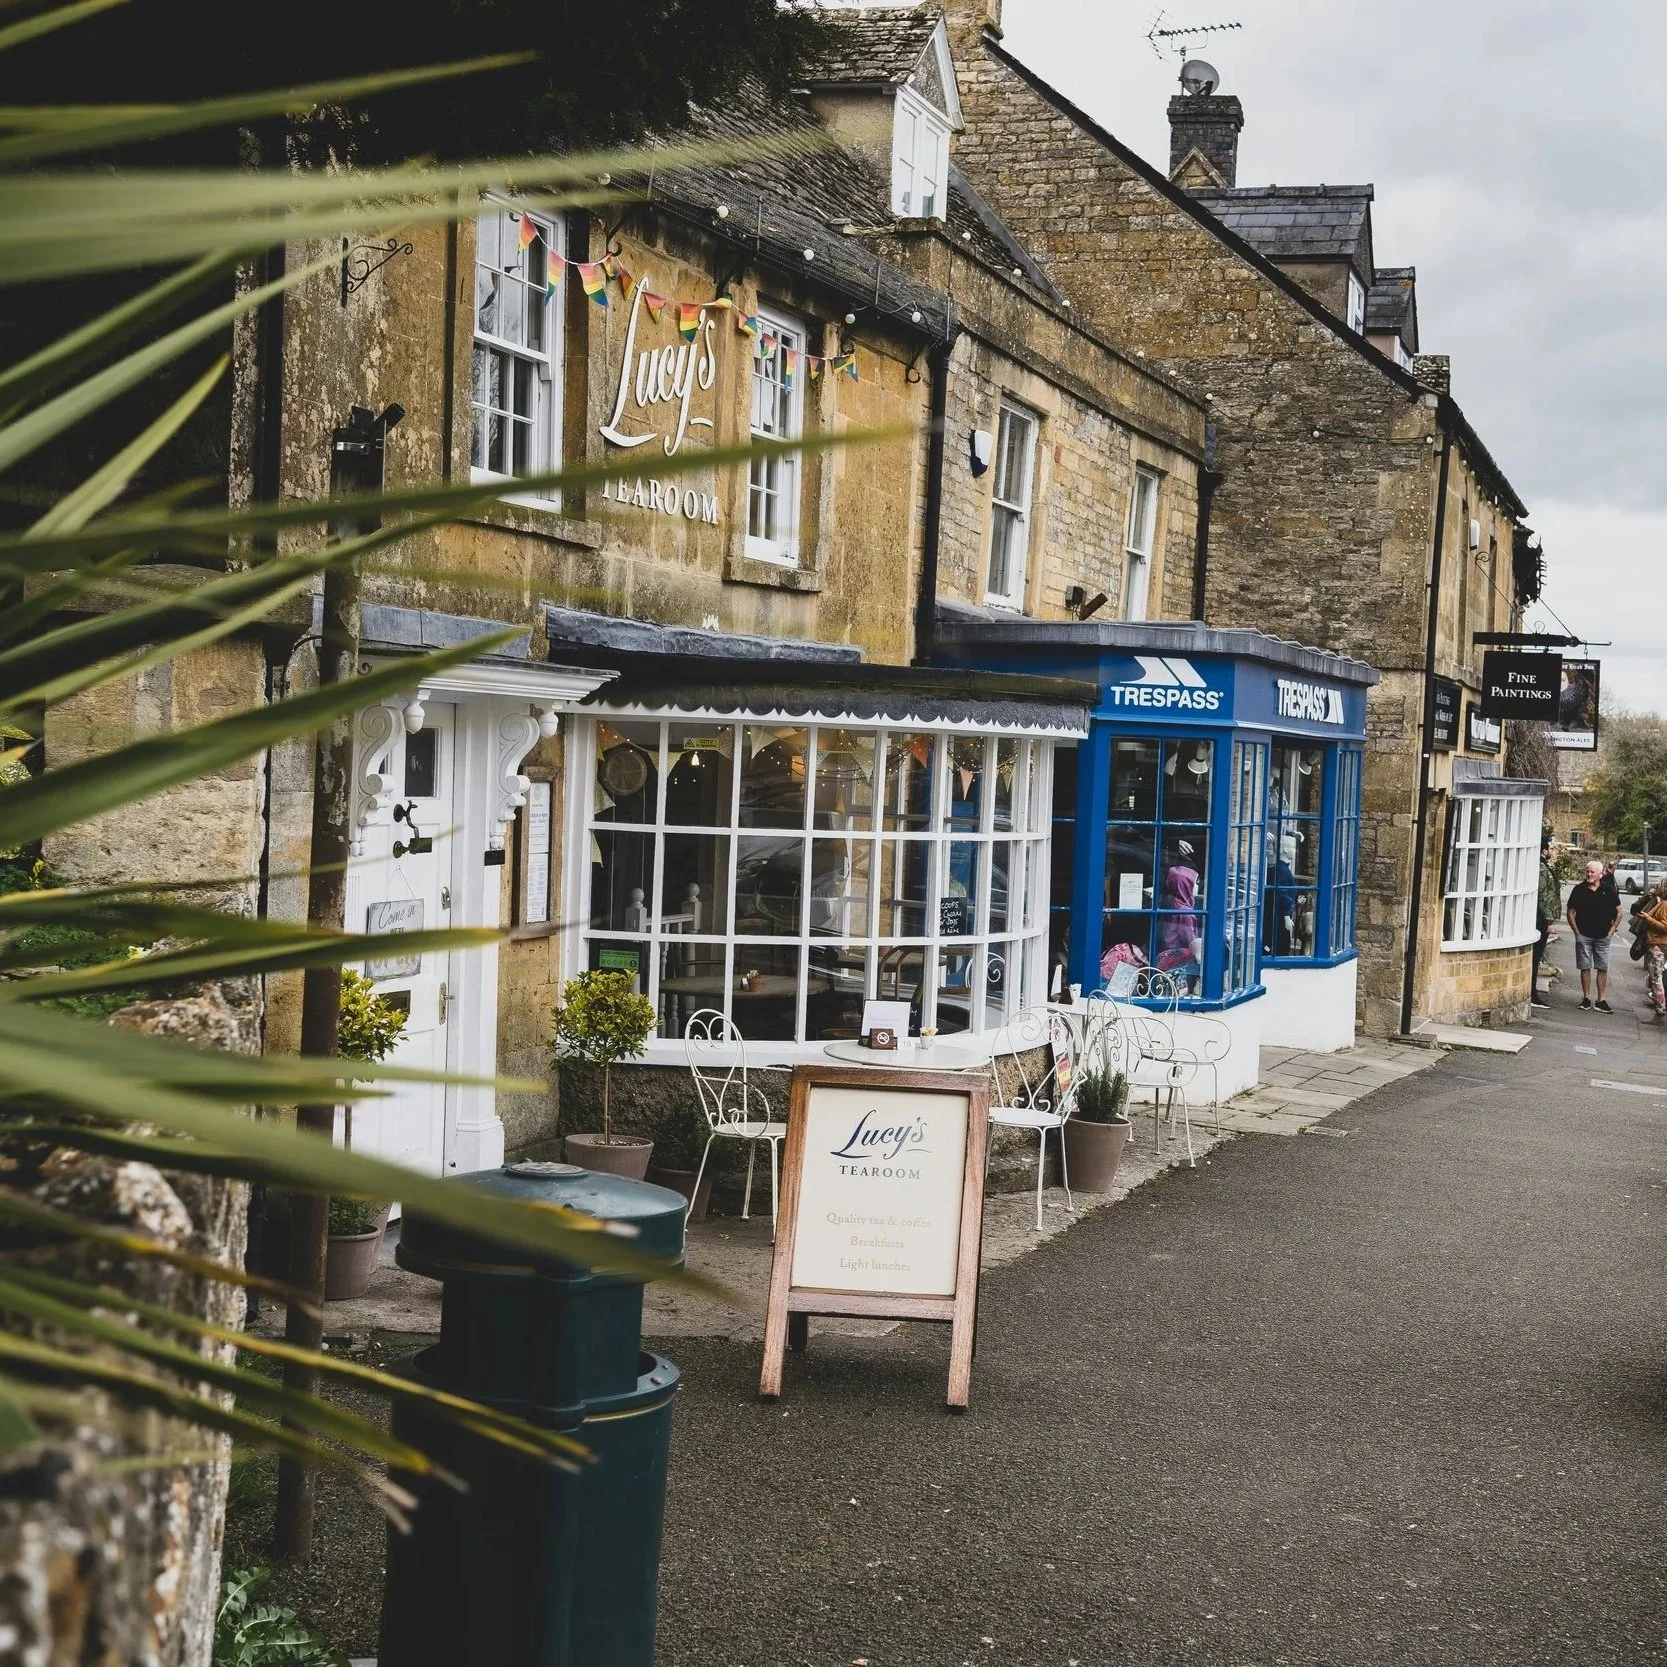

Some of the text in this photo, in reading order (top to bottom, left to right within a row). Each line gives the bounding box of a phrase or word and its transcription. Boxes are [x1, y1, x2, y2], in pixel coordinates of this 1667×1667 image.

[600, 276, 716, 457] Lucy's
[1110, 685, 1220, 711] TRESPASS
[1277, 679, 1326, 722] TRESPASS
[830, 1109, 932, 1160] Lucy's
[839, 1165, 921, 1180] TEAROOM
[826, 1211, 933, 1229] Quality tea & coffee
[850, 1235, 905, 1249] Breakfasts
[839, 1257, 913, 1273] Light lunches
